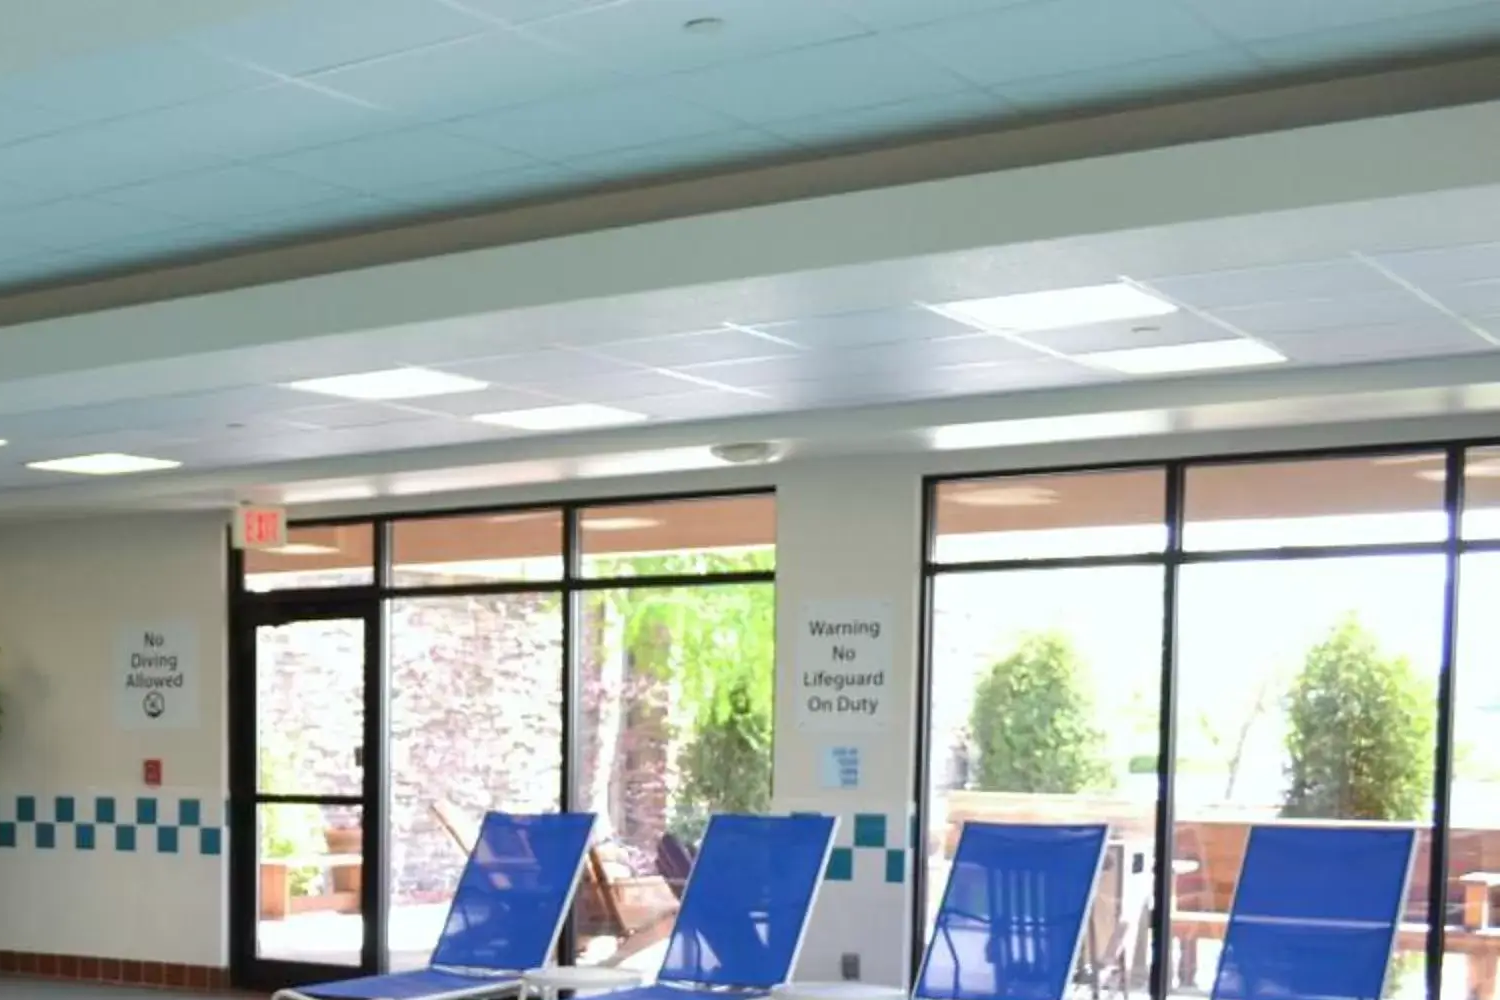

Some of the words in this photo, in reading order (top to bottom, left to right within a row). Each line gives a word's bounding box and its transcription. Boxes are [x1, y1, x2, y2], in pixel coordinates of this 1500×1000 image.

[244, 511, 278, 544] EXIT
[808, 619, 881, 639] Warning
[144, 631, 165, 648] No
[131, 651, 178, 671] Diving
[831, 644, 856, 661] No
[124, 671, 184, 688] Allowed
[803, 670, 885, 691] Lifeguard
[807, 695, 832, 712] On
[837, 695, 879, 715] Duty
